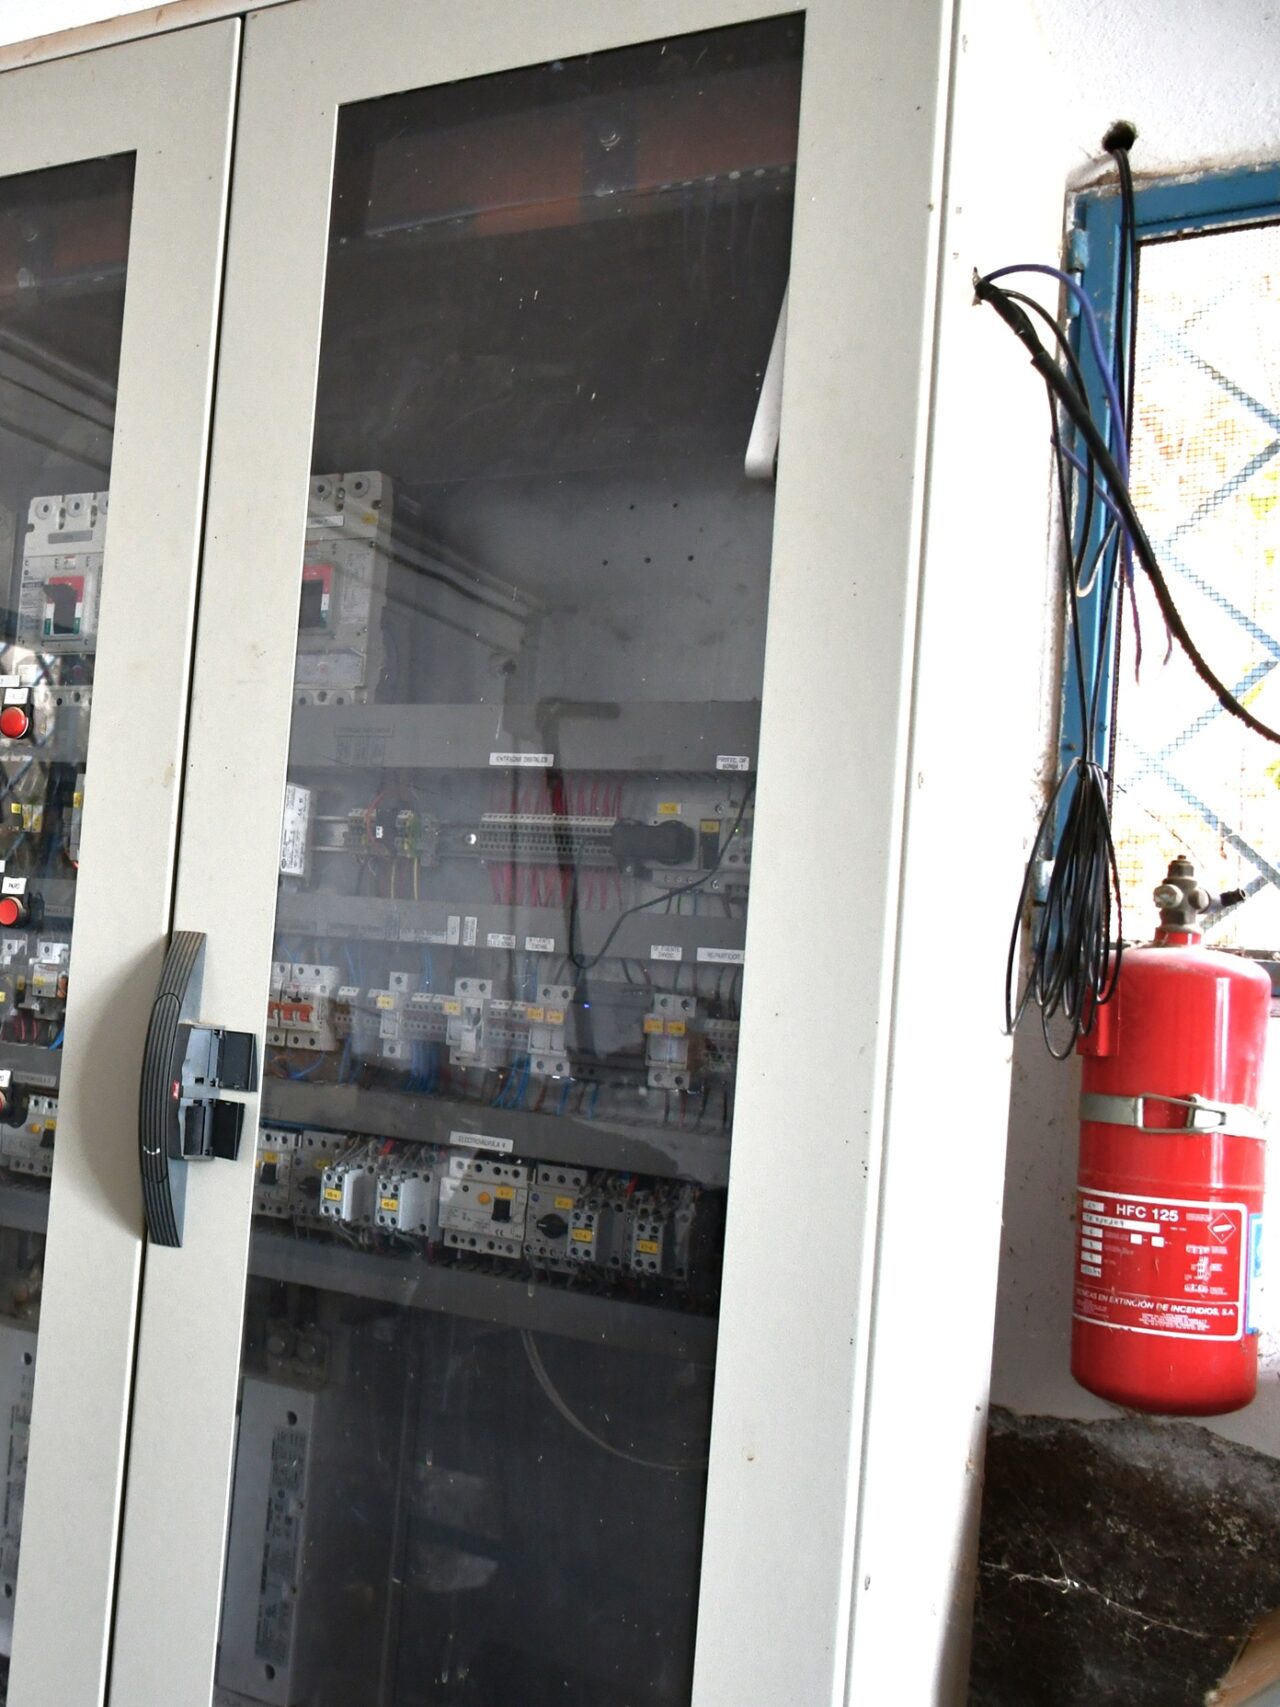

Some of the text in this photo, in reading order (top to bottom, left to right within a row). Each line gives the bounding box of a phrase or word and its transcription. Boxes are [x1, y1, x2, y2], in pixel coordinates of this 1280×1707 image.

[1116, 1203, 1147, 1219] HFC
[1151, 1208, 1179, 1222] 125
[1109, 1296, 1154, 1309] EXTINCIÓN
[1157, 1303, 1169, 1312] DE
